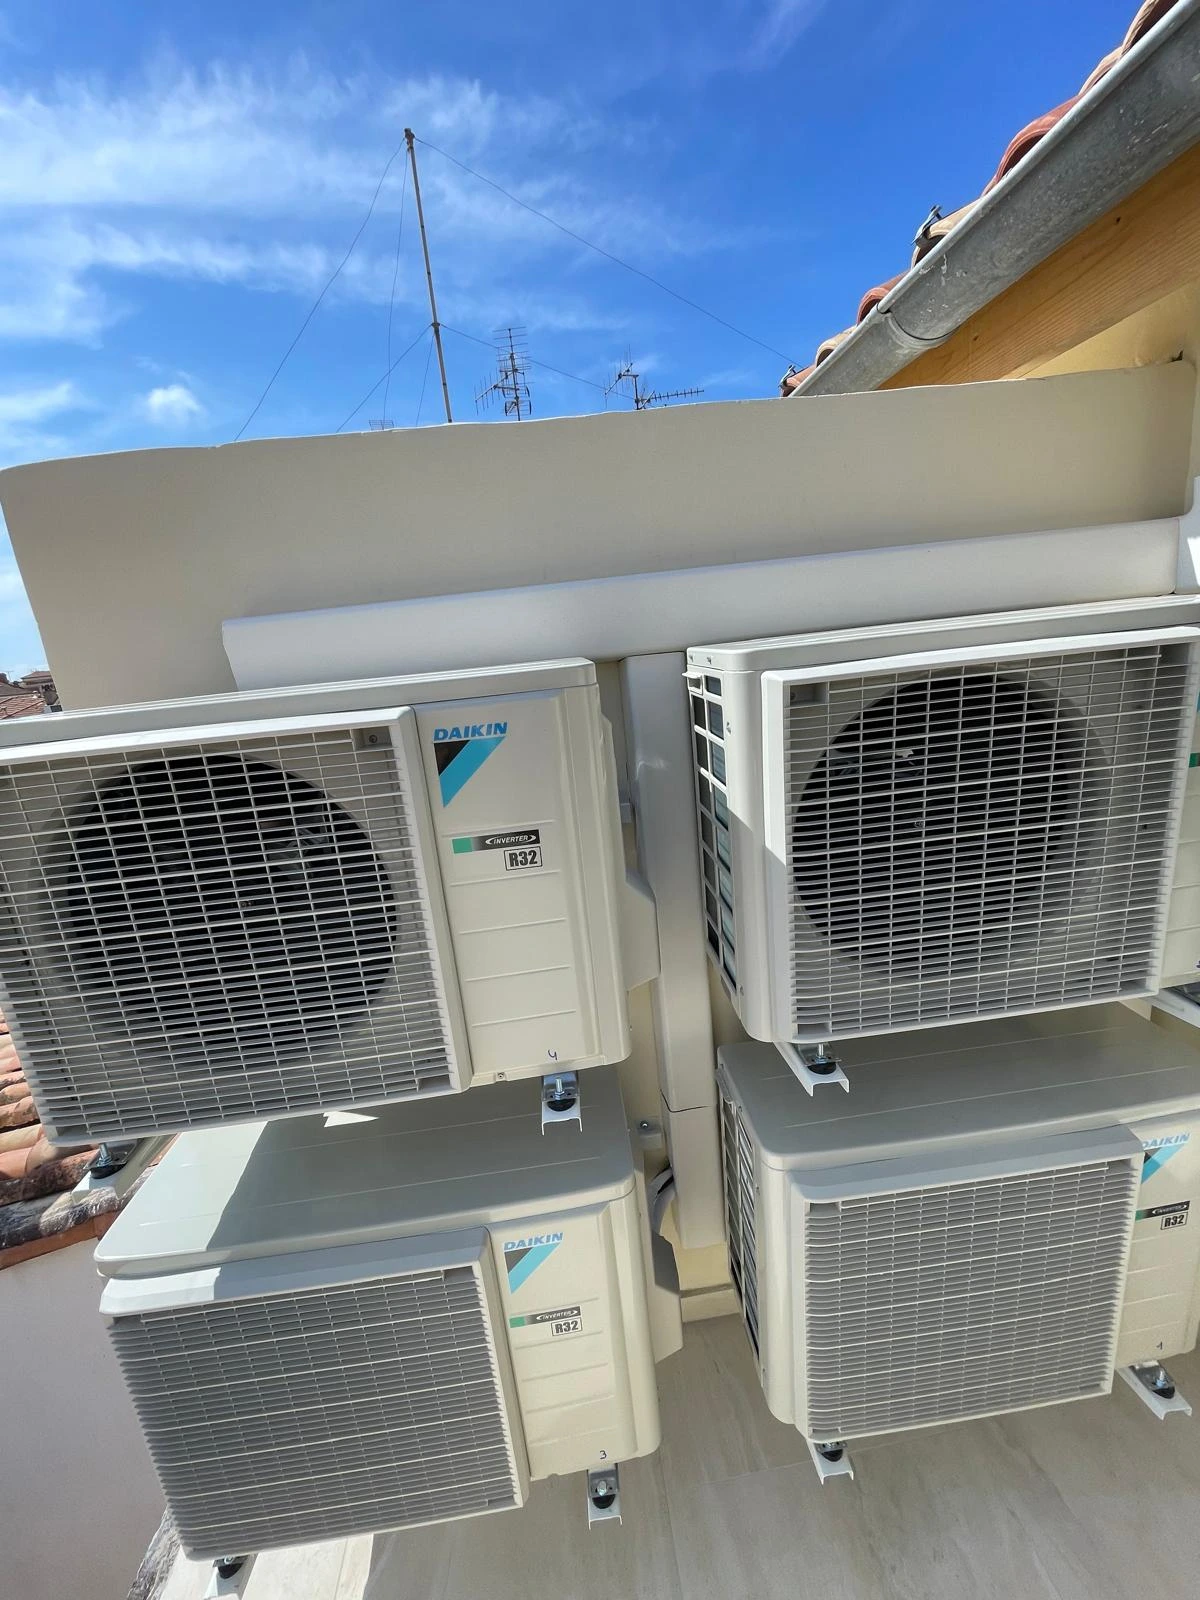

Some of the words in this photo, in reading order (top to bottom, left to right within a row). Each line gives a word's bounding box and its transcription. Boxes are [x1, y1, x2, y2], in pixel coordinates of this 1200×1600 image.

[433, 721, 508, 741] DAIKIN
[493, 834, 529, 844] INVERTER
[508, 849, 538, 867] R32
[1164, 1214, 1184, 1227] R32
[504, 1232, 563, 1250] DAIKIN
[542, 1310, 572, 1319] INVERTER
[555, 1321, 579, 1334] R32
[599, 1450, 607, 1460] 3
